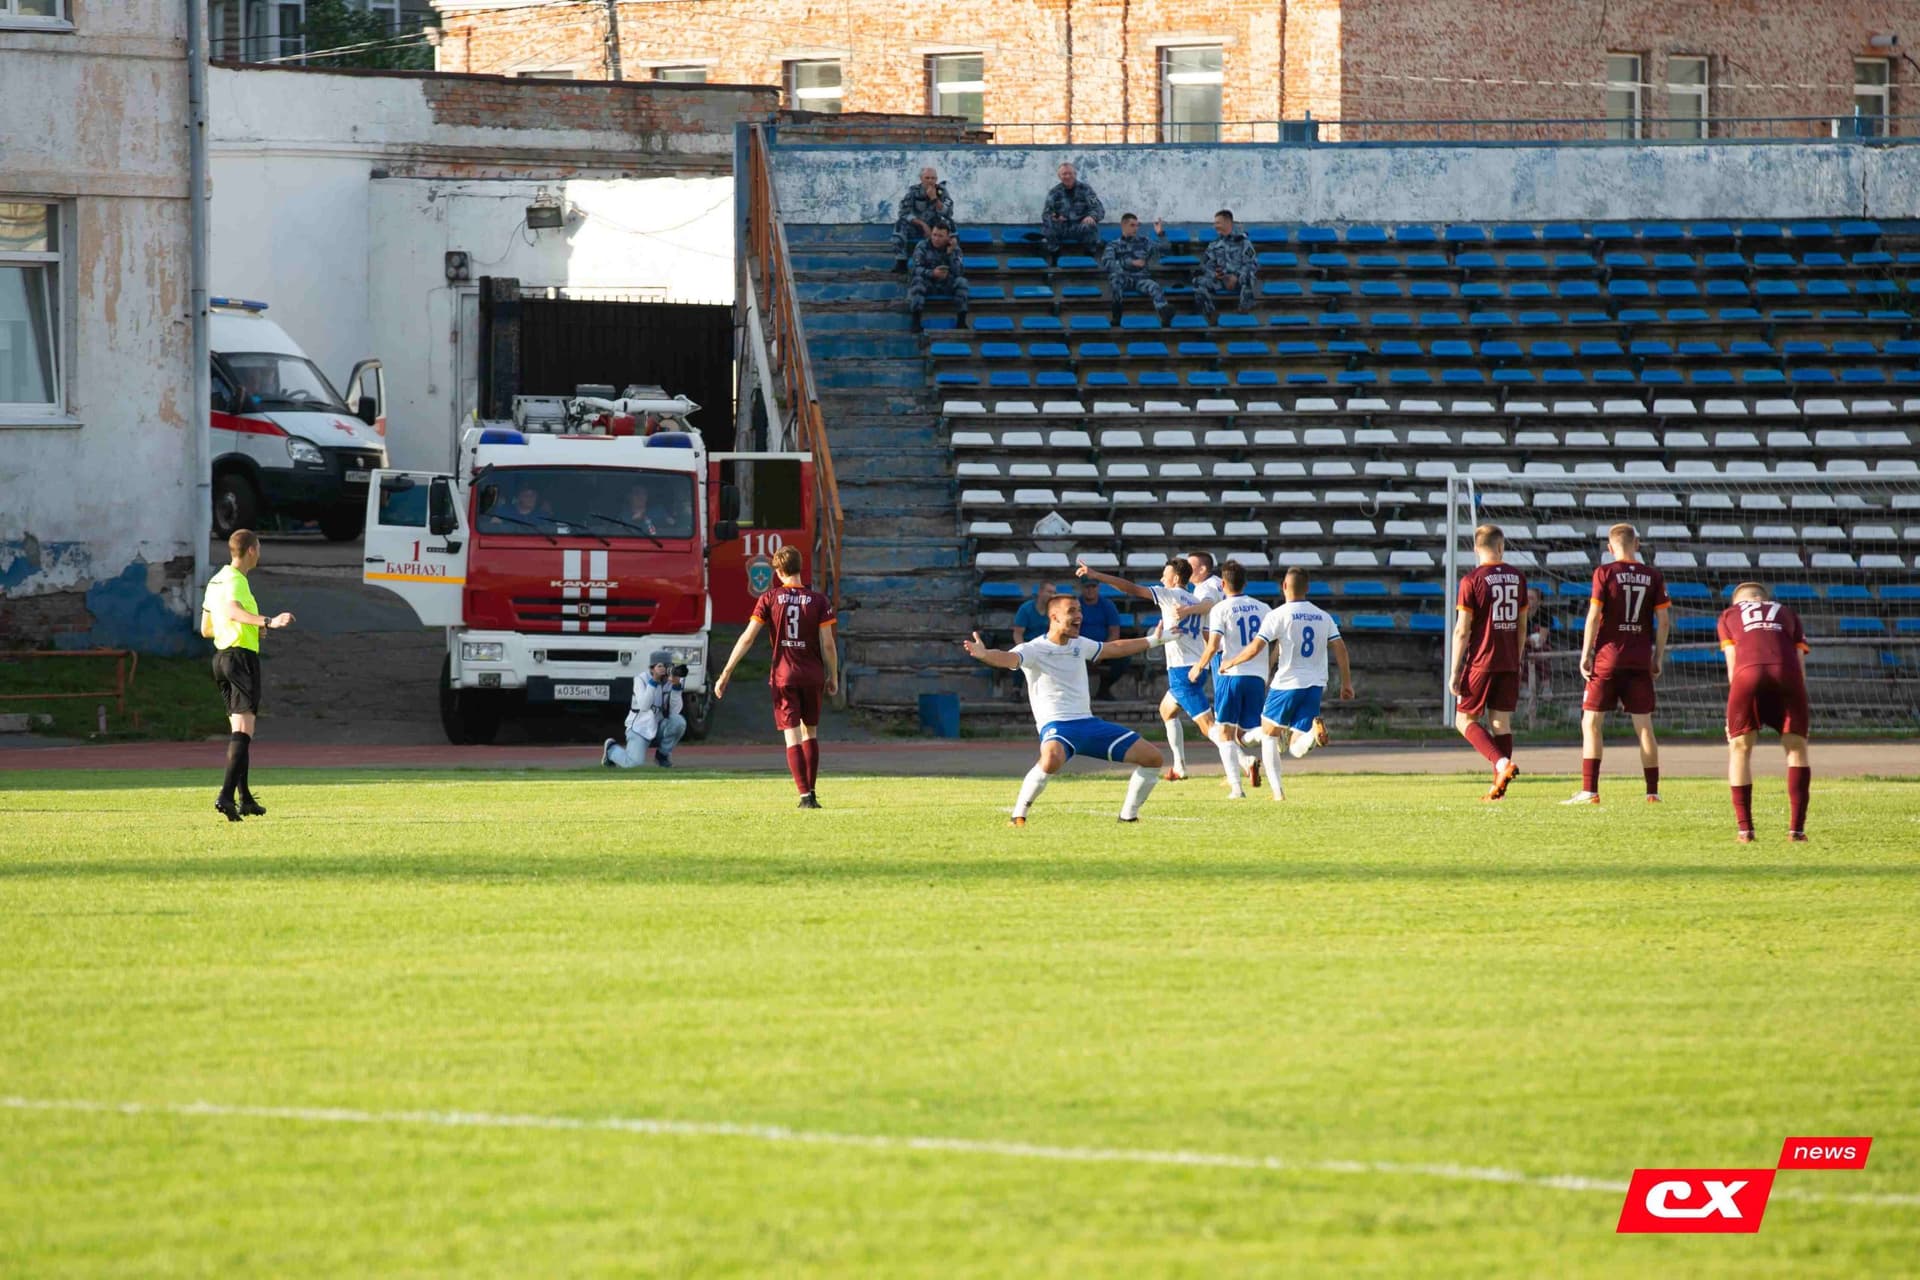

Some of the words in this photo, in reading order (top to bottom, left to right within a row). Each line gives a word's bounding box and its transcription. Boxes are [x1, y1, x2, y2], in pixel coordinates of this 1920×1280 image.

[412, 540, 421, 561] 1
[742, 533, 783, 556] 110
[386, 562, 446, 577] БАРНАУЛ
[1491, 584, 1518, 621] 25
[1623, 584, 1646, 623] 17
[1739, 600, 1782, 626] 27
[786, 605, 800, 639] 3
[1178, 613, 1201, 640] 24
[1236, 614, 1261, 646] 18
[1301, 626, 1315, 657] 8
